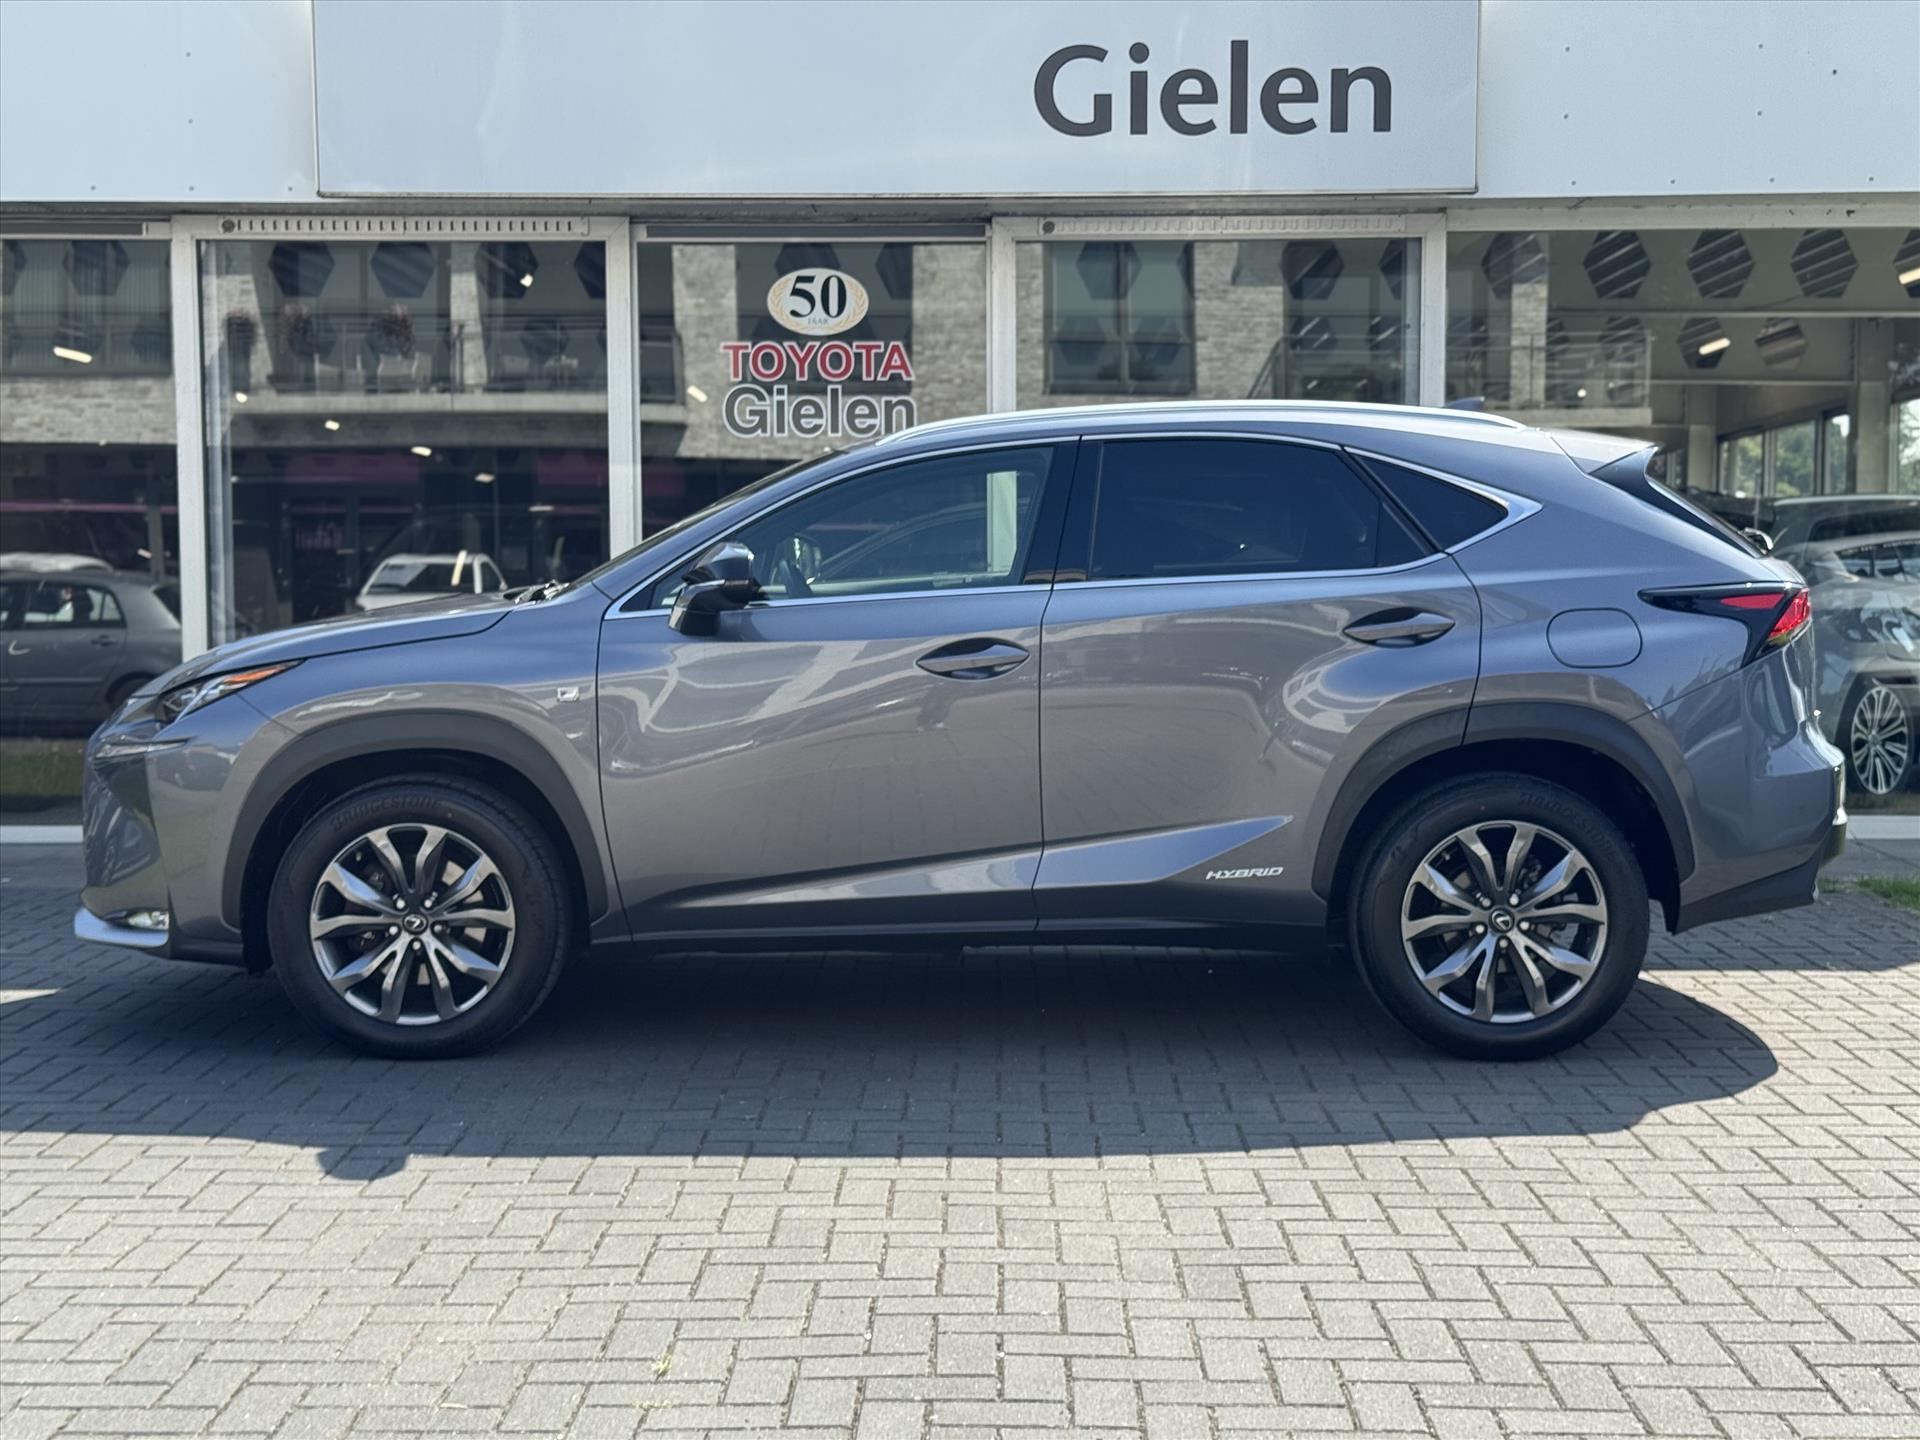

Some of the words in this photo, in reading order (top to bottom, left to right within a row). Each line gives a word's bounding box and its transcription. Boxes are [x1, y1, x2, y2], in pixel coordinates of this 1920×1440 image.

[1034, 40, 1392, 137] Gielen
[789, 274, 847, 318] 50
[721, 341, 915, 381] TOYOTA
[723, 384, 917, 438] Gielen
[1205, 866, 1284, 880] HYBRID
